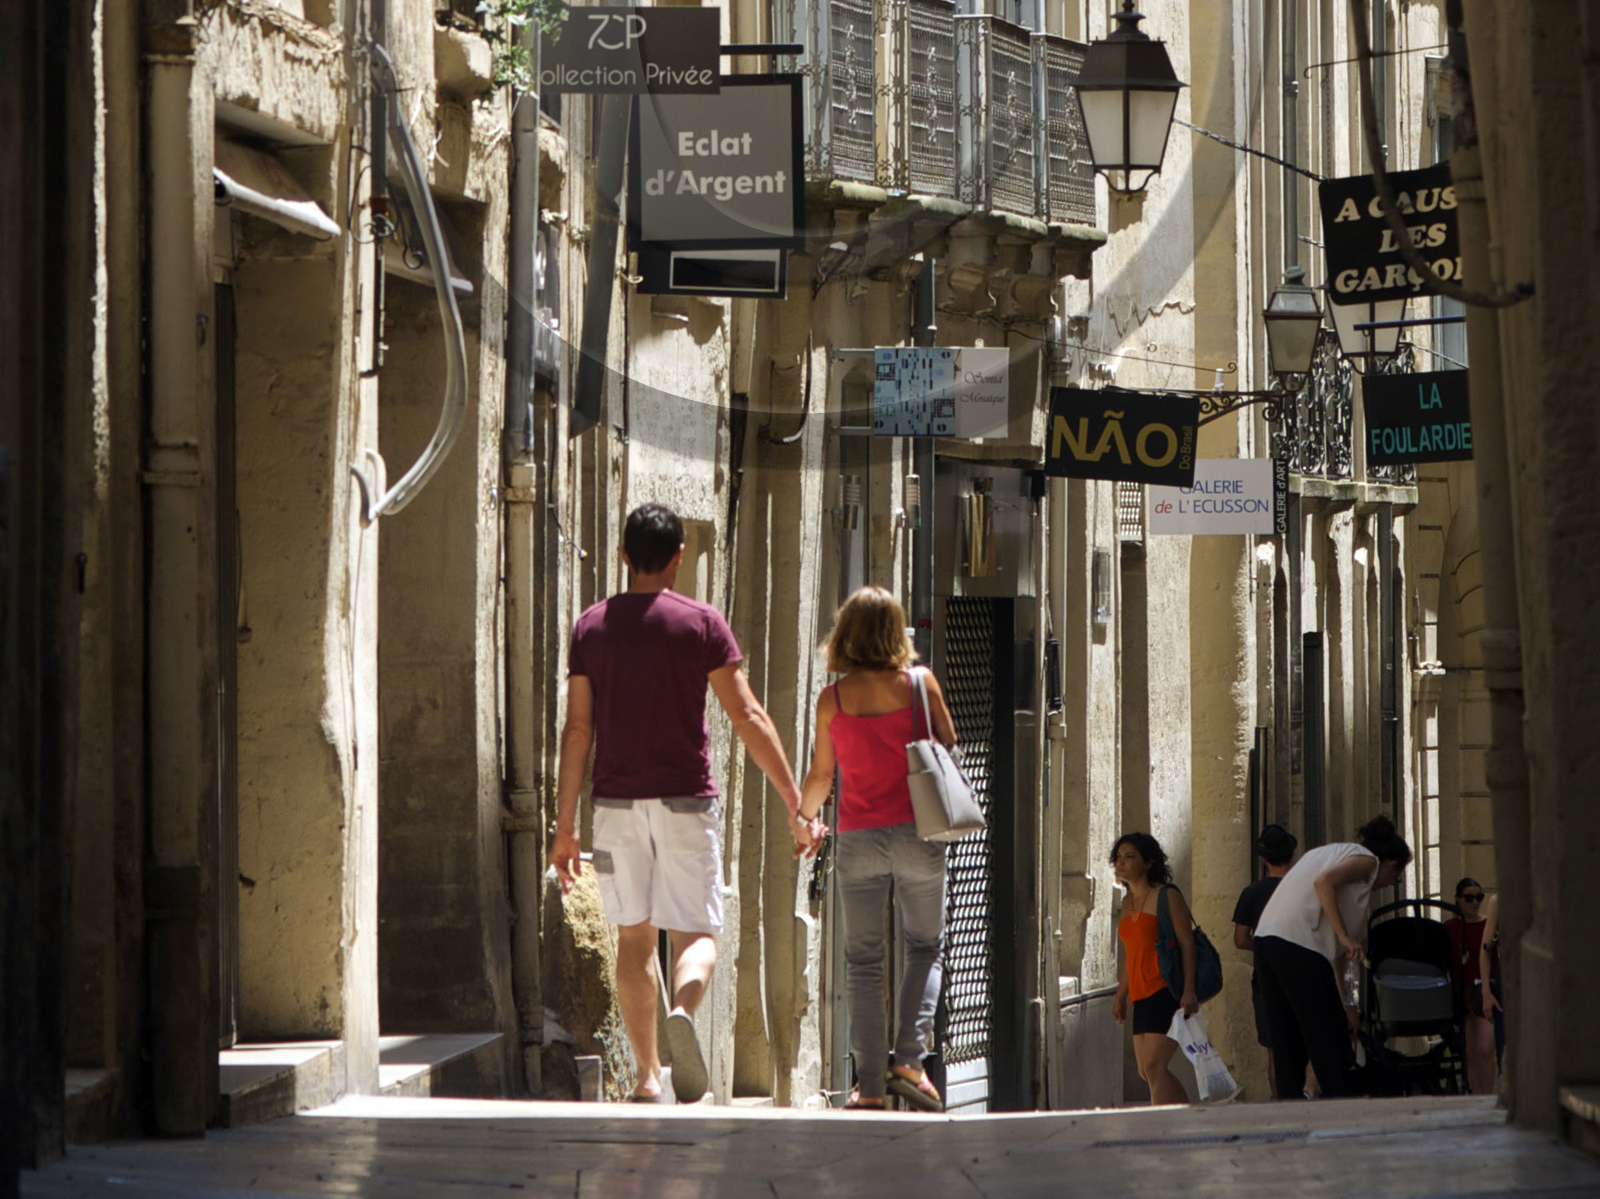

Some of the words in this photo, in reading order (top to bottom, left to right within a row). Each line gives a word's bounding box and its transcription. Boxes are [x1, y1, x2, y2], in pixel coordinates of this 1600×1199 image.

[540, 63, 637, 86] ollection
[645, 61, 714, 86] Privée
[677, 129, 753, 157] Eclat
[645, 169, 786, 202] d'Argent
[1334, 197, 1361, 223] A
[1367, 185, 1459, 219] CAUS
[1378, 223, 1448, 254] LES
[1418, 381, 1443, 410] LA
[1051, 408, 1179, 468] NÃO
[1180, 425, 1193, 455] Brasil
[1370, 422, 1473, 456] FOULARDIE
[1179, 455, 1191, 470] Do
[1154, 499, 1173, 515] de
[1276, 490, 1287, 534] GALERIE
